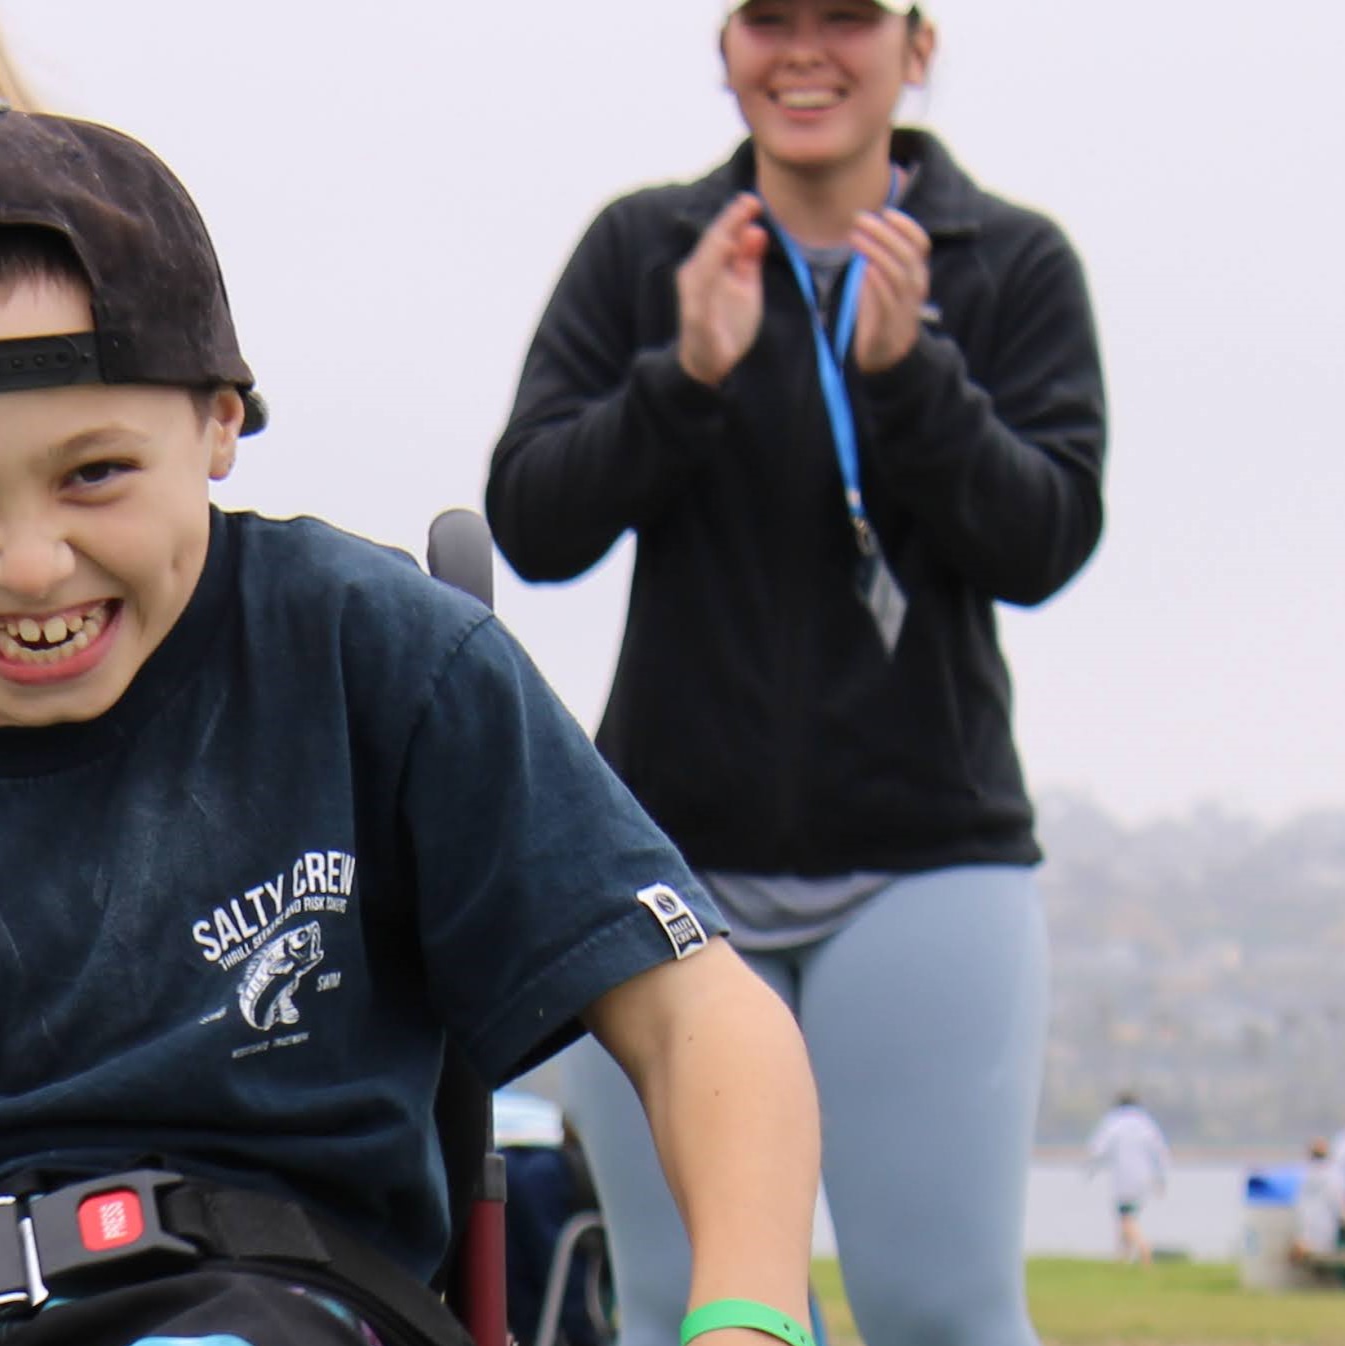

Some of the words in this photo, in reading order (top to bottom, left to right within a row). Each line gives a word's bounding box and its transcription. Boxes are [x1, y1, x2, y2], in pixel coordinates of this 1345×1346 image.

[192, 873, 285, 962] SALTY
[292, 850, 356, 897] CREW
[218, 942, 253, 972] THRILL
[99, 1200, 129, 1241] PRESS
